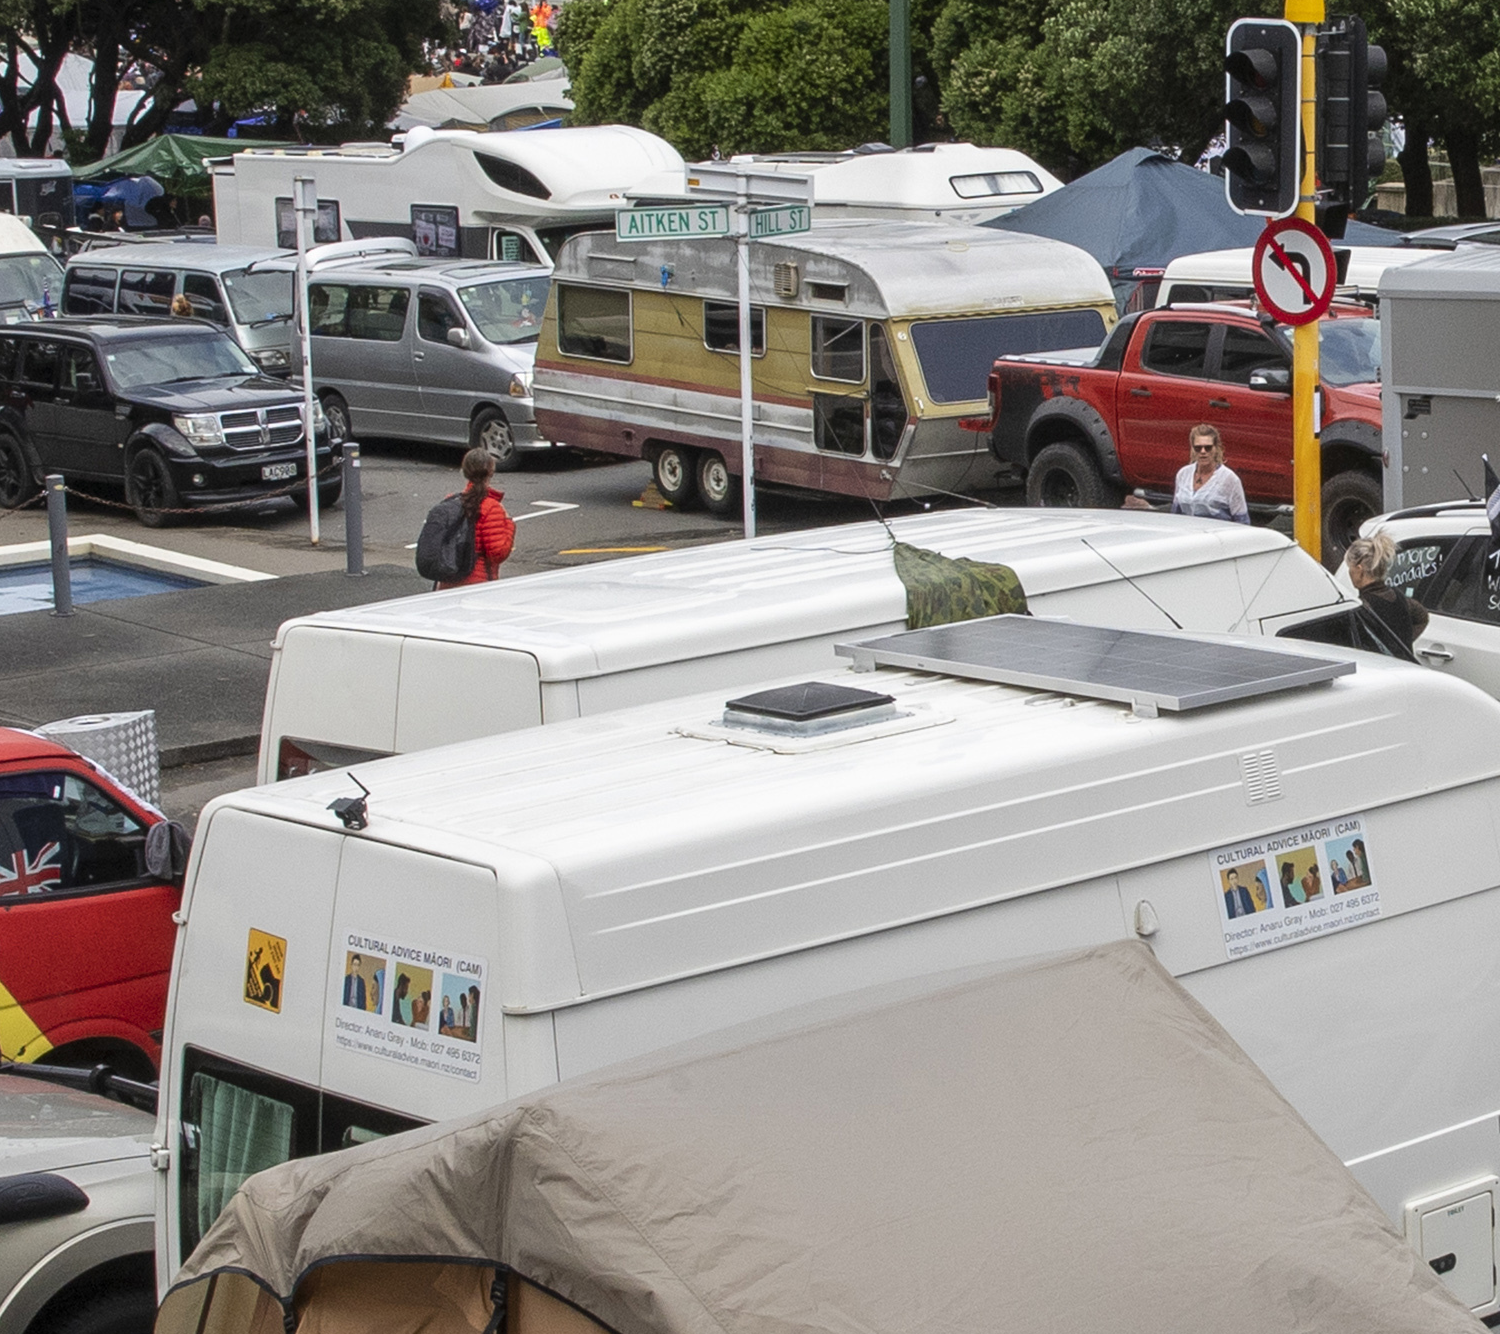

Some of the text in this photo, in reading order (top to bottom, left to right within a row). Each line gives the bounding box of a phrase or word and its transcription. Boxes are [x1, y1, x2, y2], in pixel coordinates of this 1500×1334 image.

[628, 211, 718, 234] AITKEN ST
[756, 209, 804, 234] HILL ST
[1397, 545, 1438, 565] more
[1217, 844, 1265, 865] CULTURAL
[1267, 834, 1300, 852] ADVICE
[1334, 820, 1361, 837] (CAM)
[1225, 926, 1258, 943] Director:
[1284, 914, 1303, 928] Gray
[1309, 908, 1328, 921] Mob:
[1330, 902, 1344, 914] 027
[1361, 892, 1380, 905] 6372
[347, 934, 389, 955] CULTURAL
[390, 945, 422, 962] ADVICE
[456, 960, 483, 978] (CAM)
[335, 1017, 363, 1033] Director:
[387, 1031, 405, 1047] Gray
[410, 1037, 429, 1051] Mob:
[431, 1042, 444, 1055] 027
[461, 1050, 481, 1064] 6372
